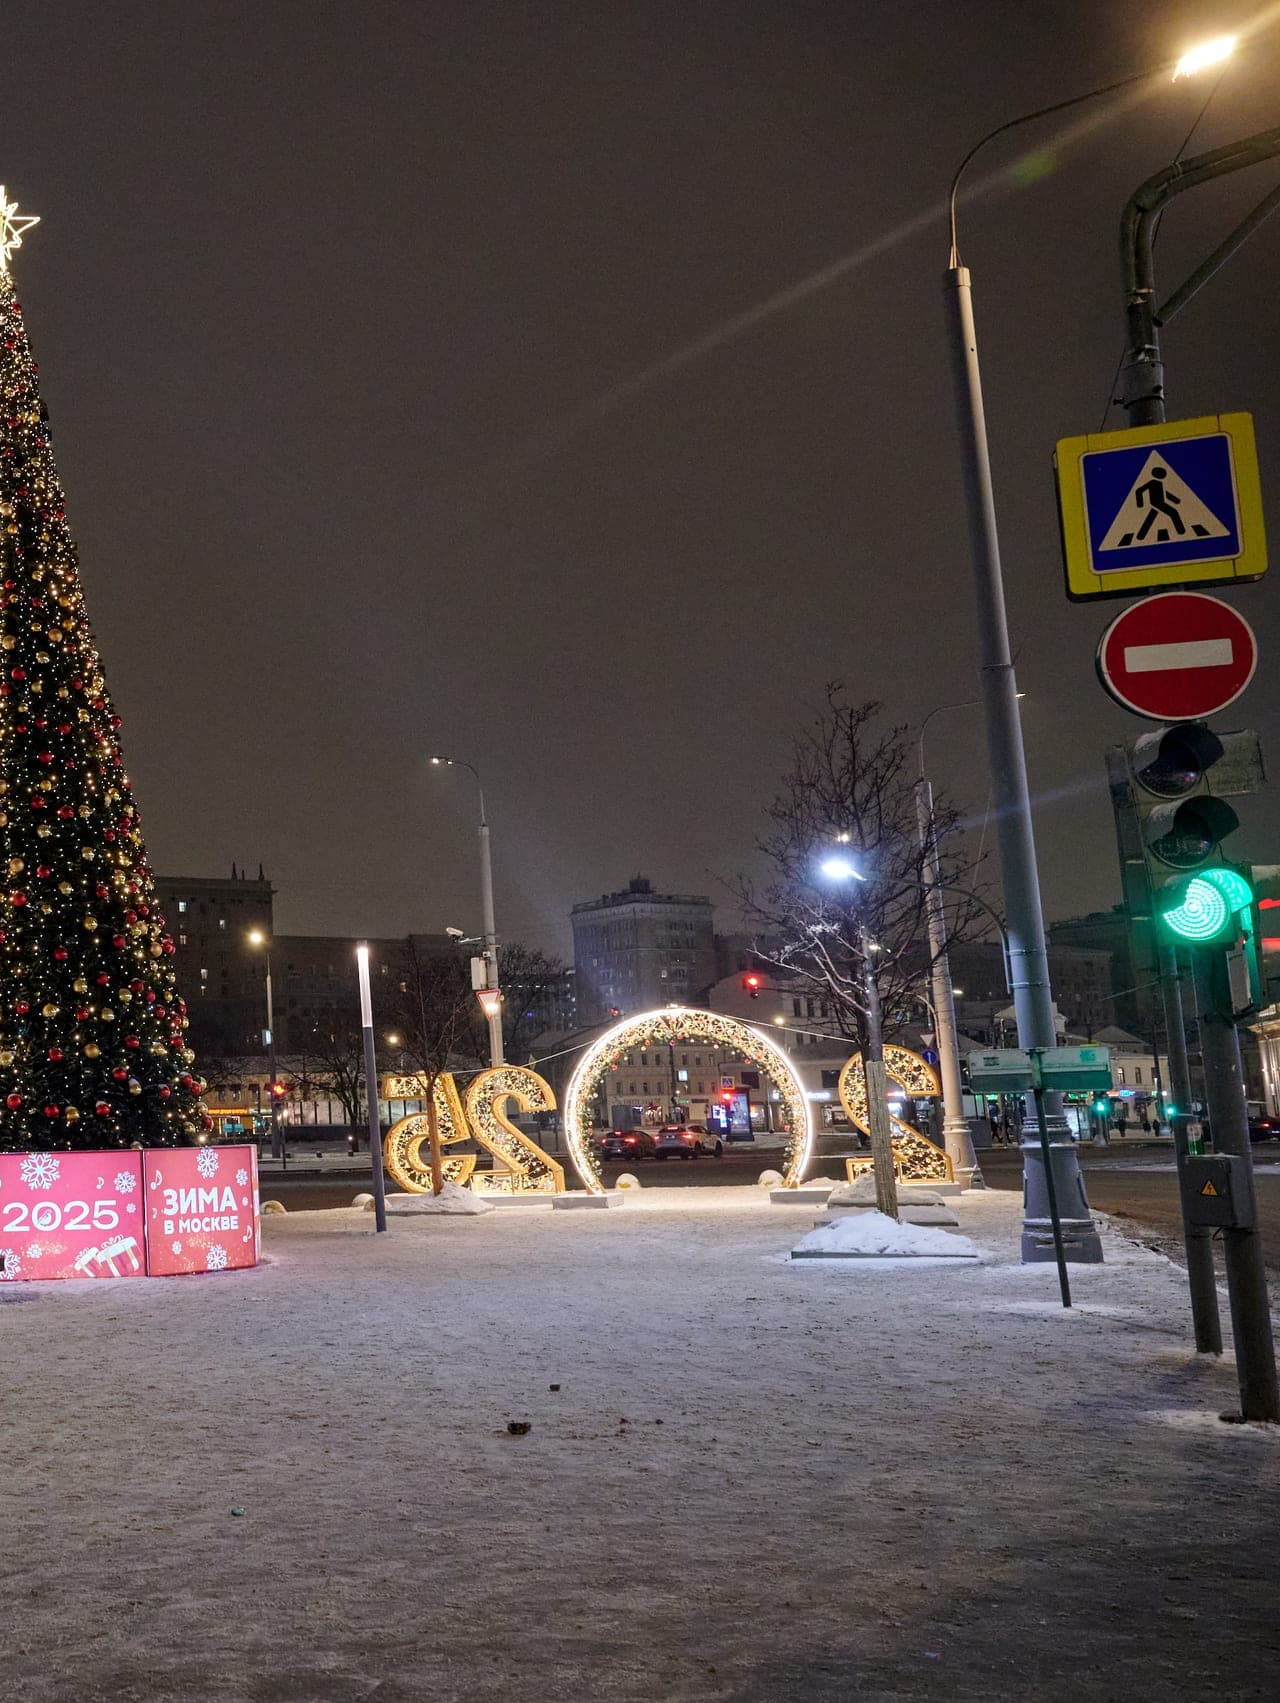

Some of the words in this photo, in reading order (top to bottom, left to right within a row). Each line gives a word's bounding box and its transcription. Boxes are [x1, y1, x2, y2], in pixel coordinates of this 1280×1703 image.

[2, 1200, 120, 1232] 2025
[163, 1186, 238, 1217] ЗИМА
[164, 1218, 175, 1235] В
[178, 1215, 240, 1234] МОСКВЕ
